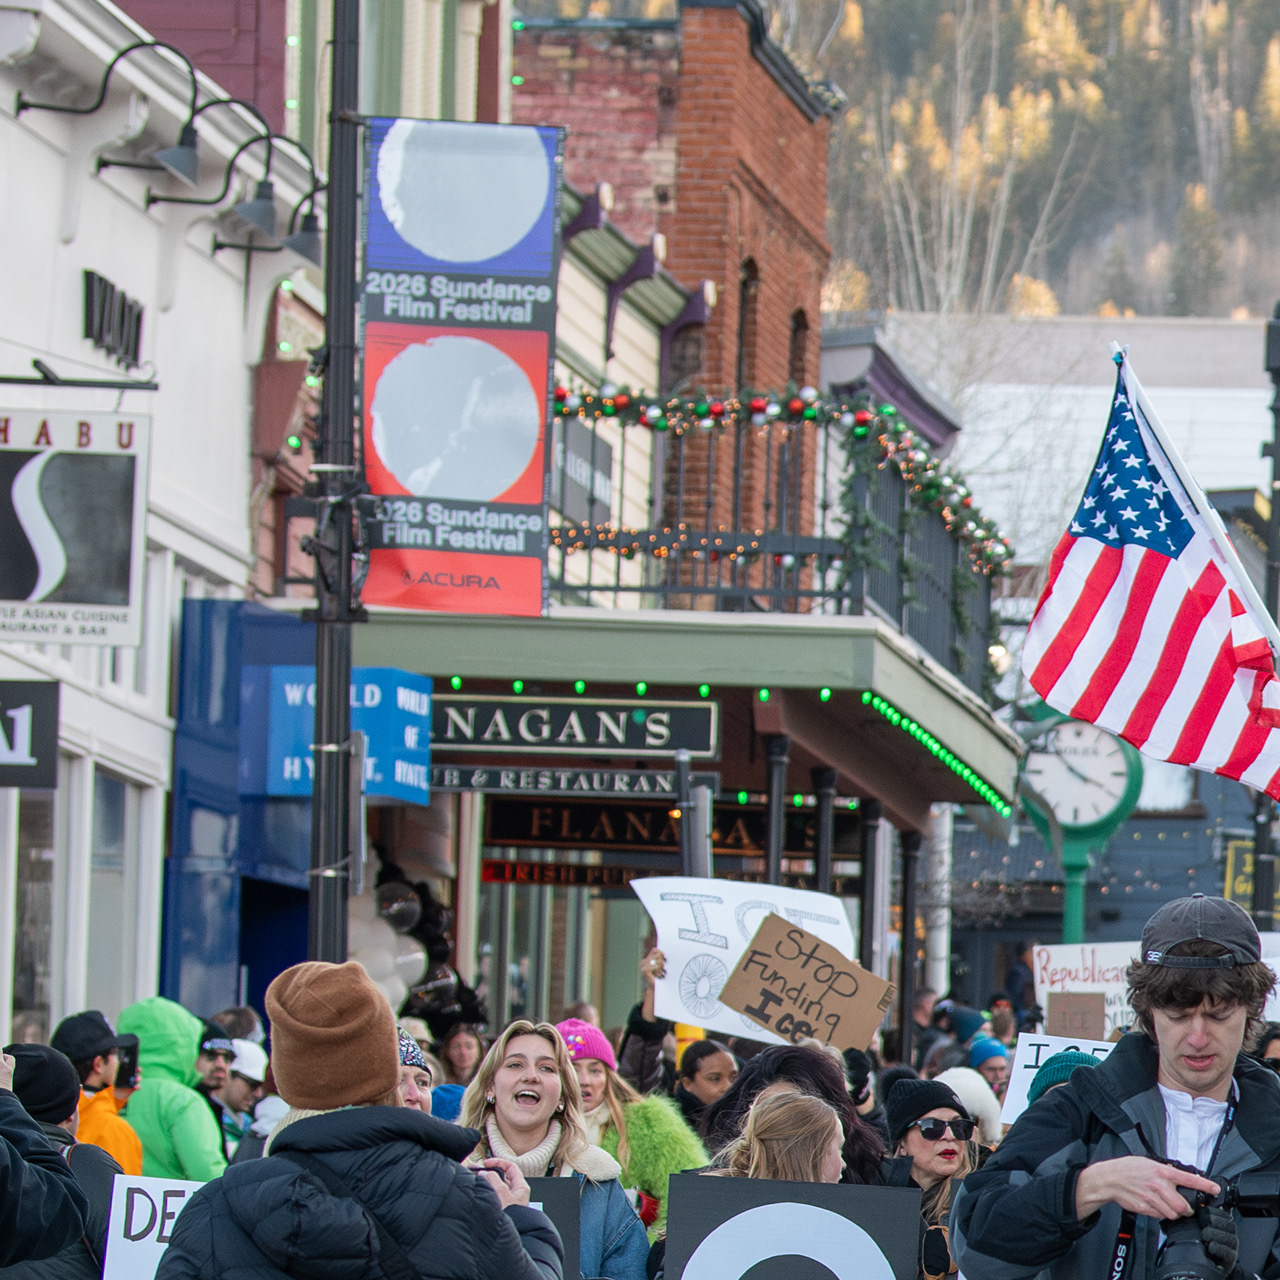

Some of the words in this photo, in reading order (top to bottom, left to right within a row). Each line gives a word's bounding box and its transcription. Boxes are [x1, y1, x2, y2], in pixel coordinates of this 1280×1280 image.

[366, 271, 428, 297] 2026
[429, 275, 552, 303] Sundance
[384, 295, 435, 319] Film
[439, 298, 533, 324] Festival
[426, 502, 543, 532] Sundance
[382, 522, 433, 545] Film
[435, 525, 526, 552] Festival
[417, 571, 501, 590] ACURA
[23, 609, 67, 620] ASIAN
[72, 611, 129, 623] CUISINE
[79, 625, 108, 636] BAR
[471, 769, 489, 786] &
[743, 949, 842, 1047] Funding
